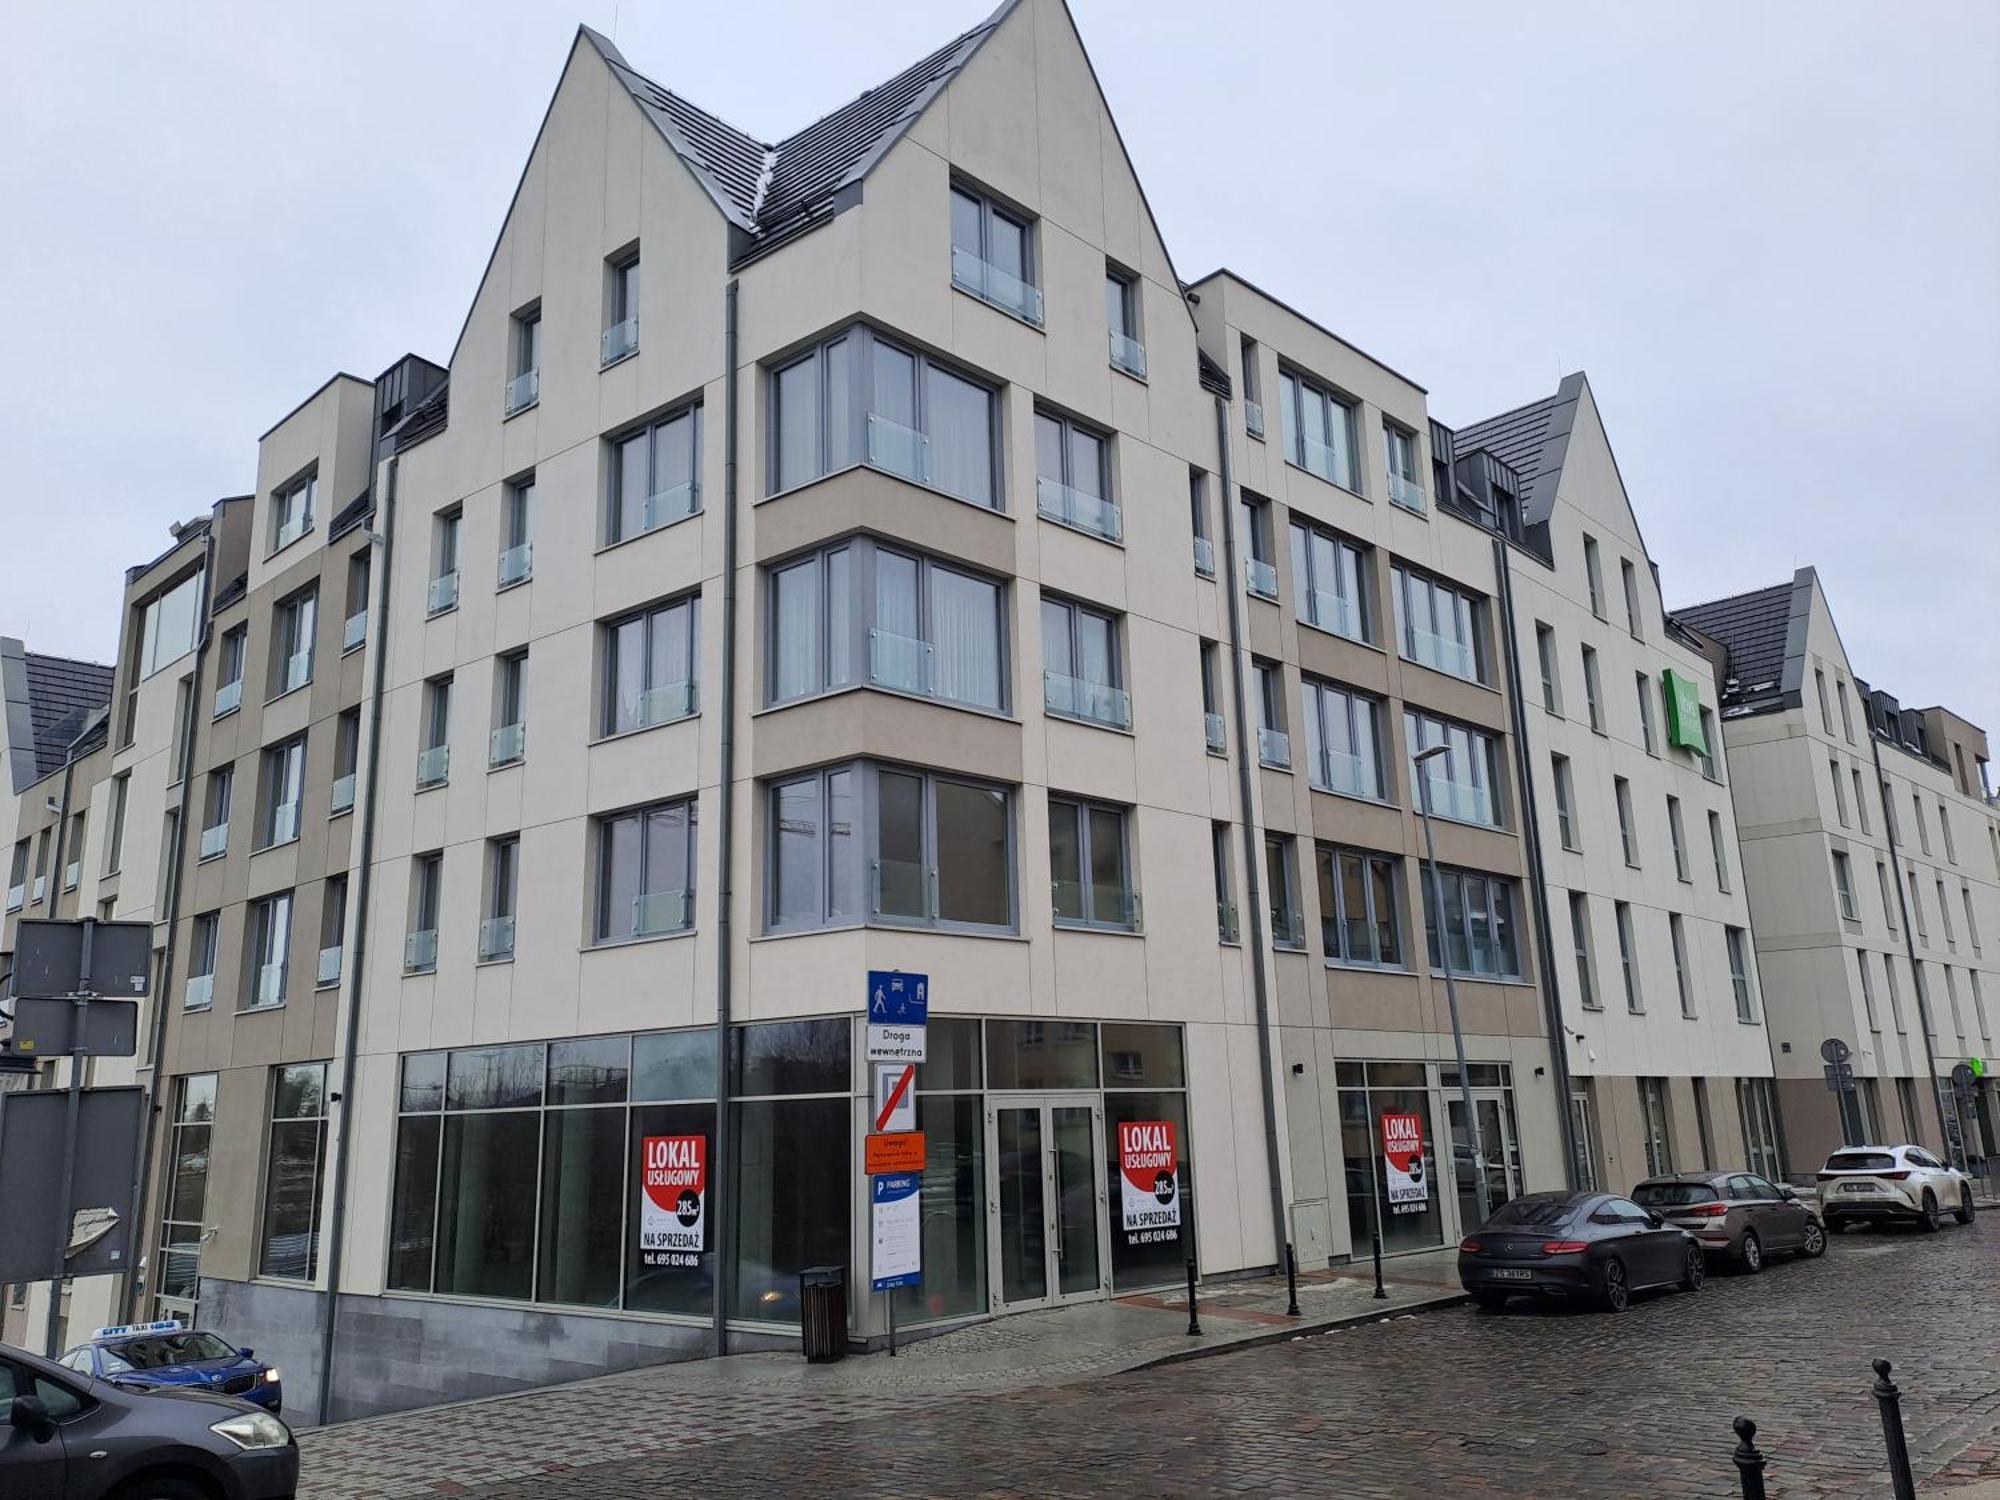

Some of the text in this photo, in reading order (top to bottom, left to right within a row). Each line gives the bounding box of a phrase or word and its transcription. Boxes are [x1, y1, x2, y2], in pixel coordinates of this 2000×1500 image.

[883, 1029, 910, 1043] Droga
[1385, 1118, 1418, 1140] LOKAL
[1123, 1125, 1171, 1153] LOKAL
[648, 1141, 700, 1169] LOKAL
[1125, 1152, 1172, 1169] USŁUGOWY
[647, 1169, 700, 1186] USŁUGOWY
[1126, 1208, 1177, 1227] NA SPRZEDAŻ
[644, 1231, 700, 1248] NA SPRZEDAŻ
[1128, 1229, 1178, 1245] tel. 695 024 686
[644, 1252, 699, 1267] tel. 695 024 686
[102, 1327, 127, 1335] CITY
